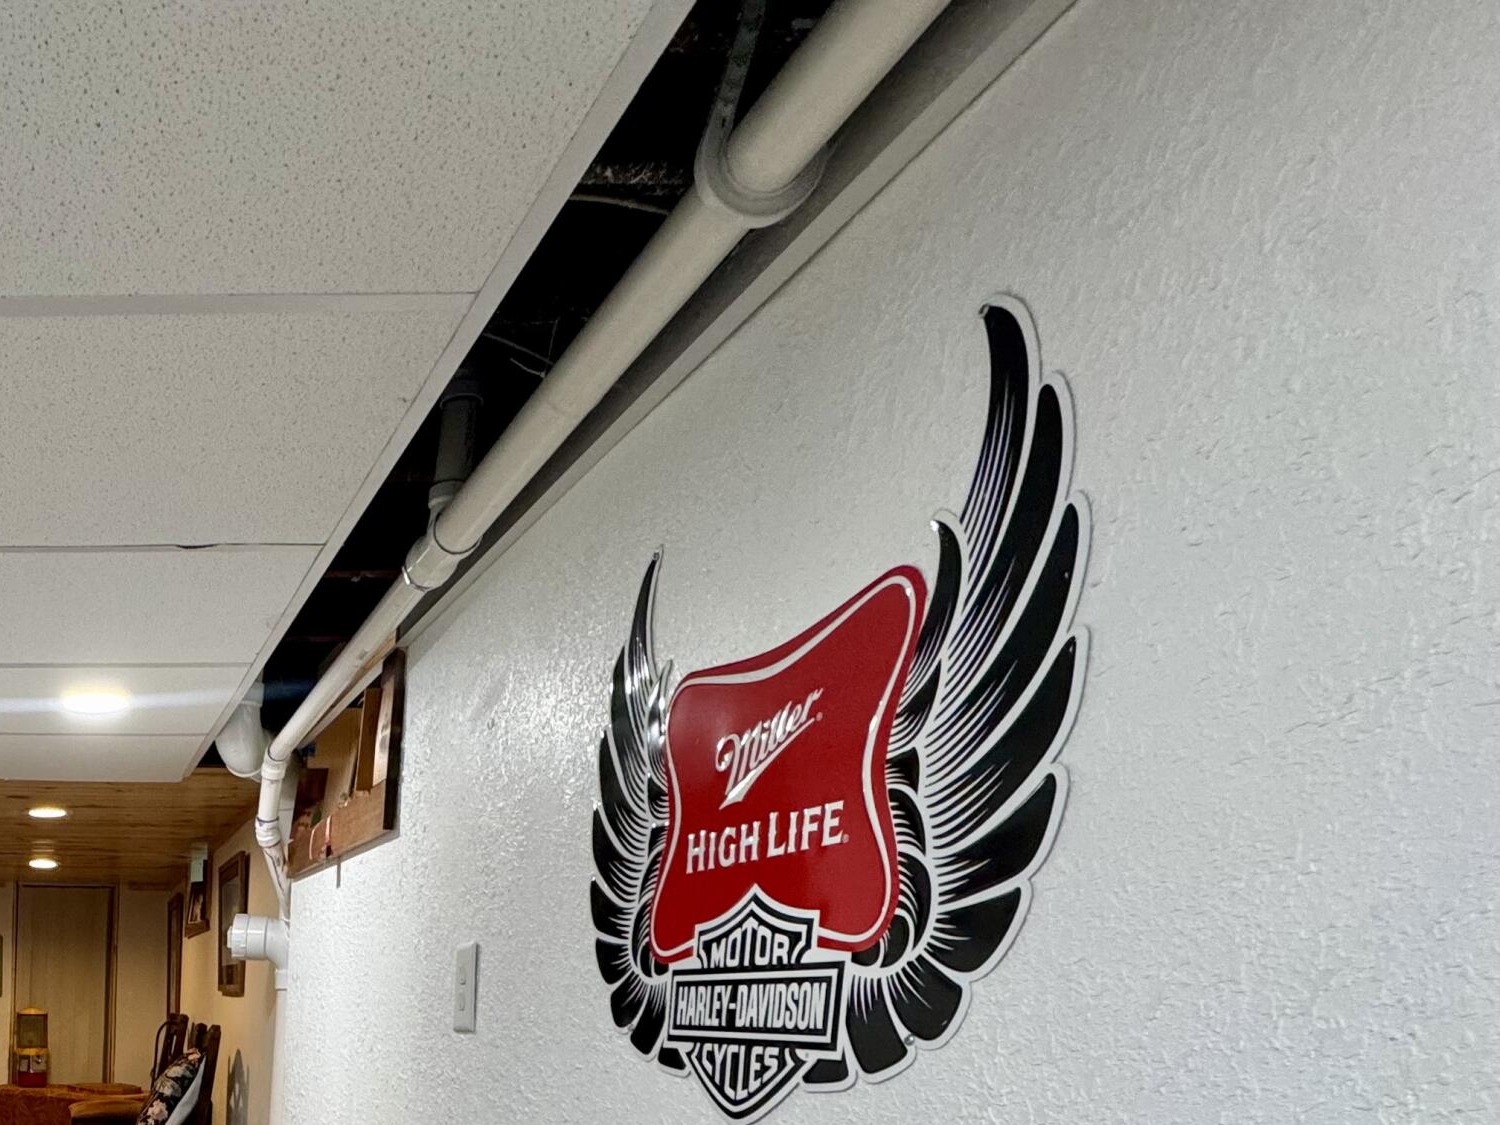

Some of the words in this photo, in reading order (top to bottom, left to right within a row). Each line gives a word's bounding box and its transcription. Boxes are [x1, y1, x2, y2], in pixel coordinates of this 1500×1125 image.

[715, 687, 824, 802] Miller
[686, 821, 761, 875] HIGH
[766, 800, 845, 858] LIFE
[710, 915, 791, 969] MOTOR
[676, 981, 828, 1031] HARLEY-DAVIDSON
[701, 1042, 780, 1101] CYCLES
